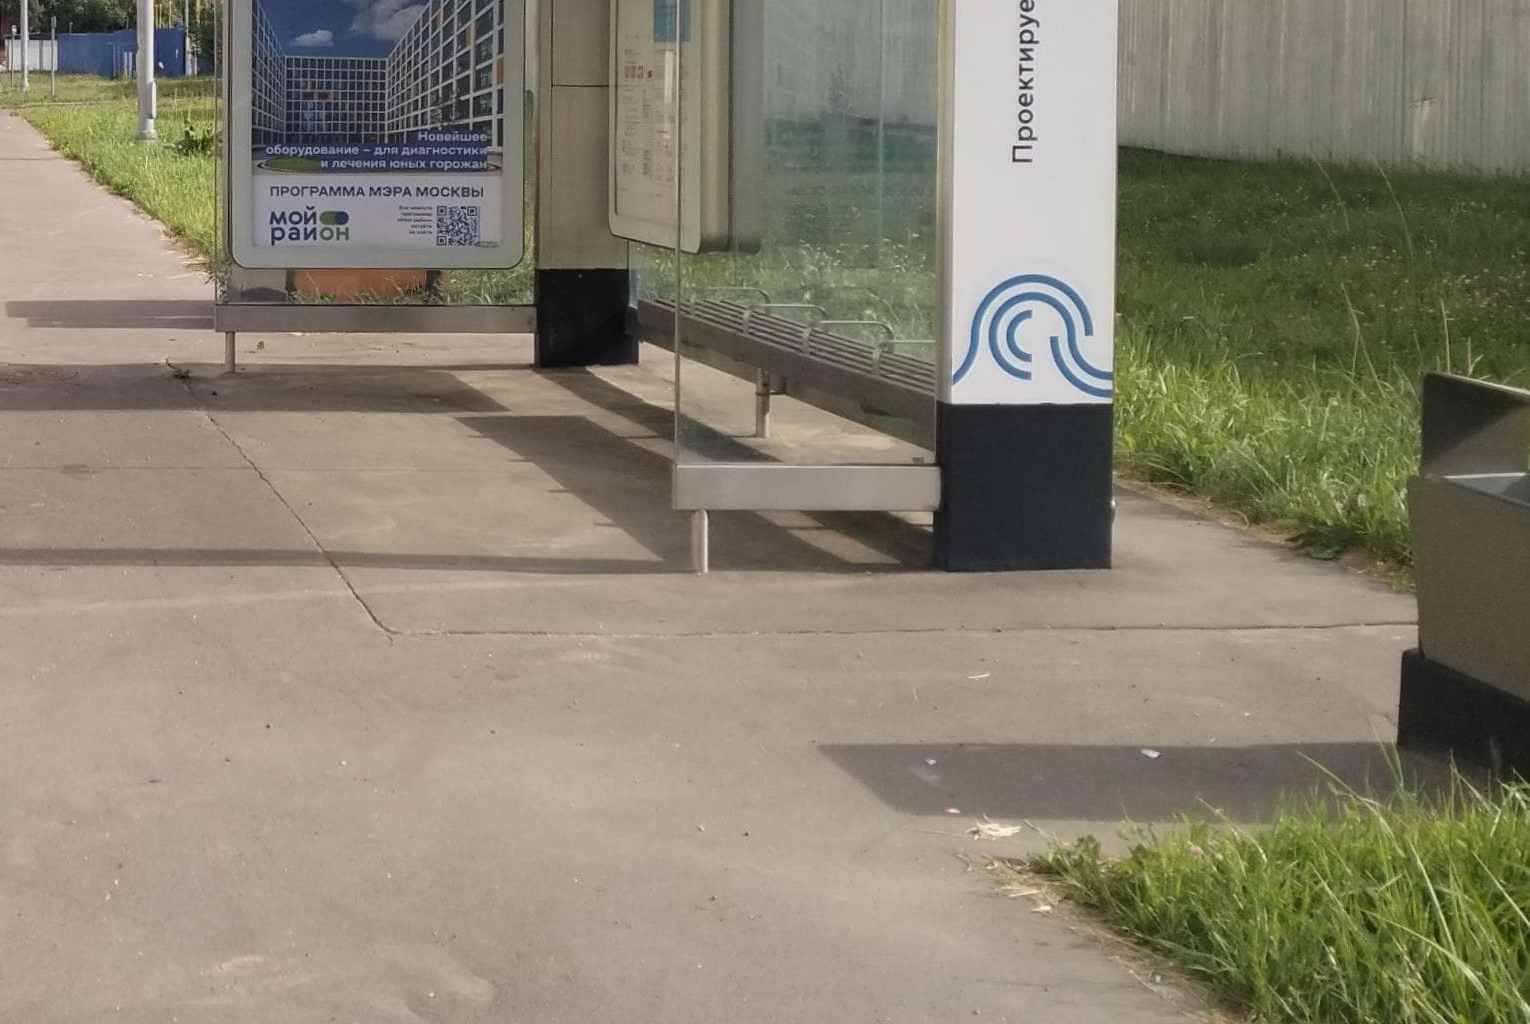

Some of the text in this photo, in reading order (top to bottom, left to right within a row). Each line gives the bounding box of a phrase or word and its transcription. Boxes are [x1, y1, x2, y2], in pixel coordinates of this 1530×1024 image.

[418, 129, 487, 142] Новейшее
[265, 144, 360, 158] оборудование
[373, 147, 399, 157] для
[401, 146, 488, 157] диагностики
[320, 159, 488, 172] и лечения юных горожан
[270, 185, 484, 198] ПРОГРАММА МЭРА МОСКВЫ
[270, 205, 317, 226] мой
